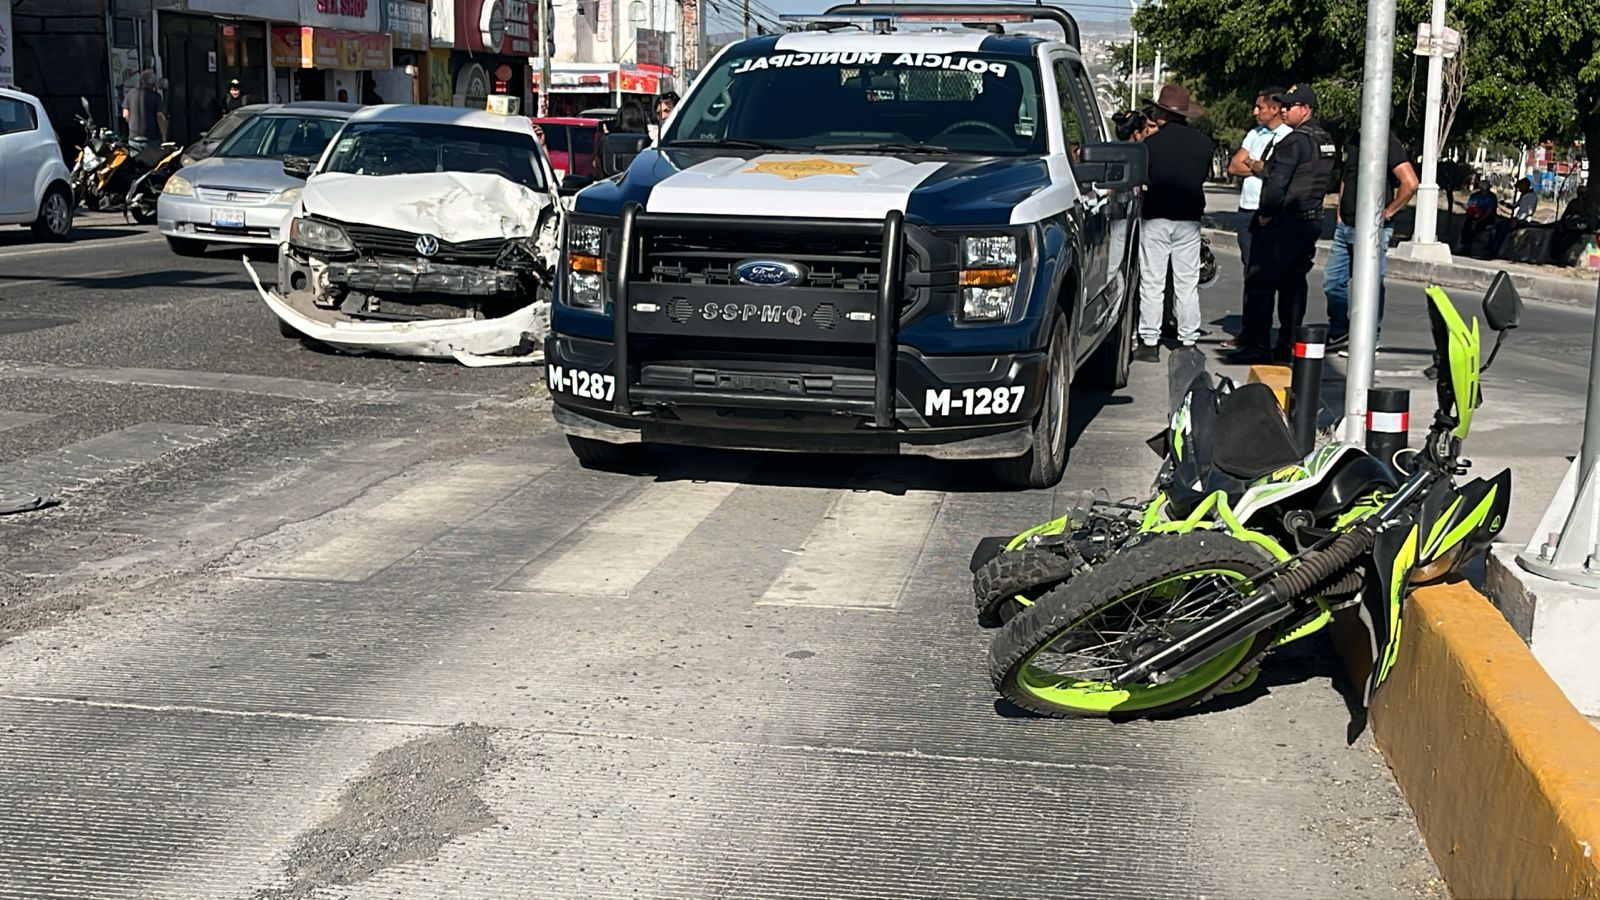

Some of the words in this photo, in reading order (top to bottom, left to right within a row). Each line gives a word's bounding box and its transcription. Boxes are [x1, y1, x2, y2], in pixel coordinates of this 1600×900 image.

[750, 266, 784, 281] Ford
[548, 364, 616, 402] M-1287
[924, 385, 1025, 416] M-1287
